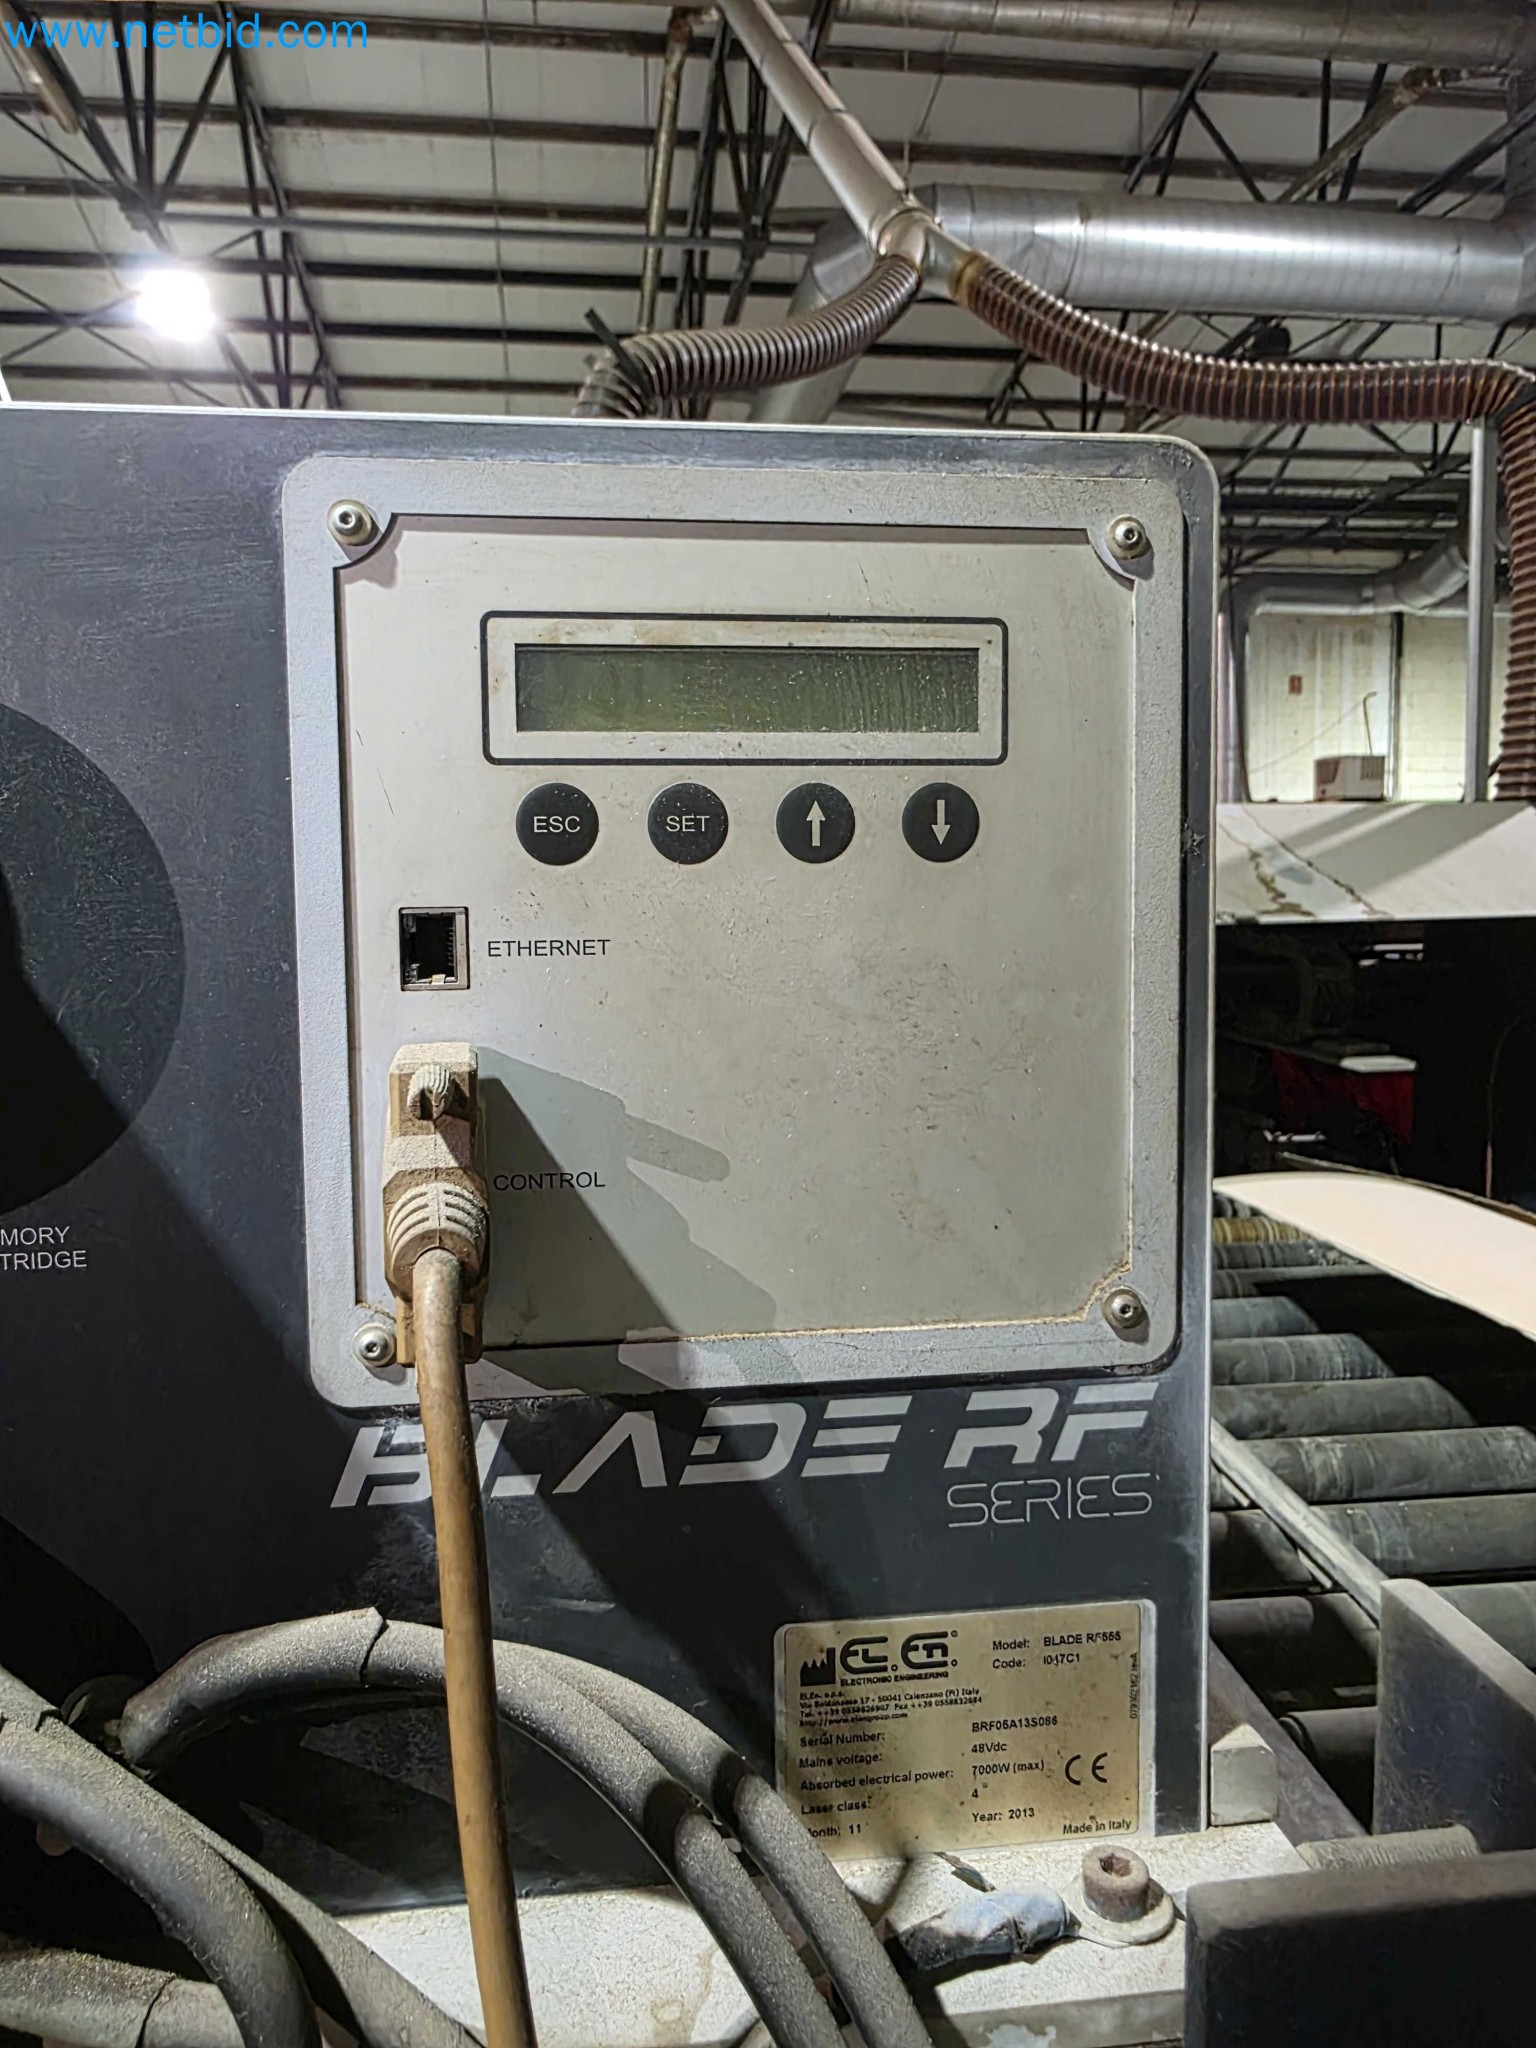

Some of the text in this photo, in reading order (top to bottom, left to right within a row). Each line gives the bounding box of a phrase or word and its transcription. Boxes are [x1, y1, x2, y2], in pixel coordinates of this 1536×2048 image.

[532, 815, 581, 834] ESC
[666, 814, 710, 833] SET
[488, 939, 611, 957] ETHERNET
[493, 1171, 606, 1191] CONTROL
[330, 1382, 1159, 1509] BLADE RF
[946, 1472, 1152, 1528] SERIES
[992, 1638, 1030, 1651] Model:
[1043, 1633, 1082, 1647] BLADE
[992, 1657, 1026, 1669] Code:
[840, 1671, 949, 1687] ELECTRONIC ENGINEERING
[800, 1732, 833, 1747] Serial
[836, 1731, 885, 1745] Number:
[799, 1741, 1007, 1768] Mains voltage: 48Vdc
[800, 1760, 1044, 1791] Absorbed electrical power: 7000W (max)
[801, 1788, 979, 1815] Laser class: 4
[849, 1823, 861, 1834] 11
[971, 1811, 1003, 1823] Year:
[1008, 1807, 1035, 1820] 2013
[1063, 1818, 1132, 1834] Made in Italy
